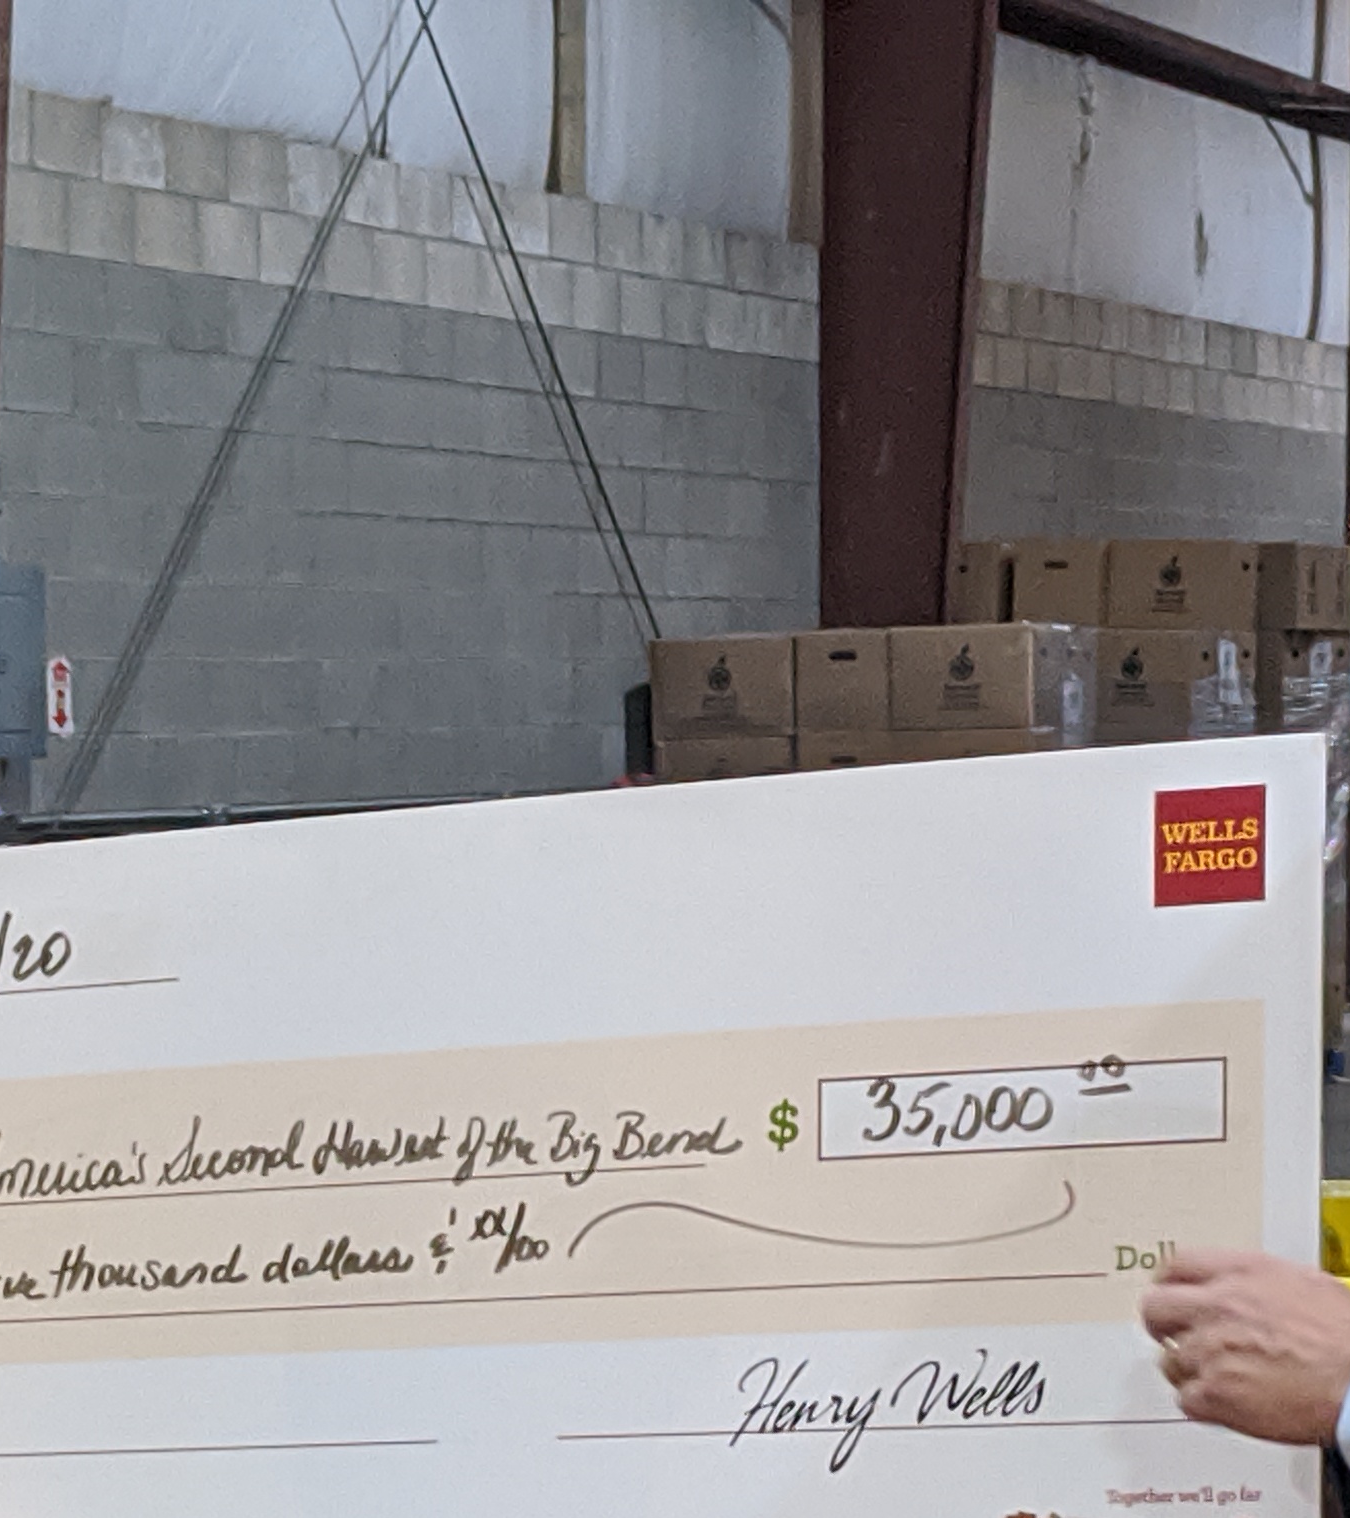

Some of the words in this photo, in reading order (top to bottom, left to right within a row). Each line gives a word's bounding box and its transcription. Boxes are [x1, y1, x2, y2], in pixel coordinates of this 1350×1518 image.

[1160, 817, 1258, 844] WELLS
[1162, 846, 1258, 874] FARGO
[767, 1098, 799, 1152] $
[862, 1076, 1054, 1146] 35,000
[157, 1116, 304, 1186] Second
[547, 1110, 602, 1187] Big
[612, 1110, 744, 1161] Bend
[49, 1243, 250, 1299] thousand
[263, 1235, 414, 1283] dollars
[1114, 1240, 1176, 1271] Doll
[729, 1357, 884, 1472] Henry
[891, 1348, 1047, 1424] Wells
